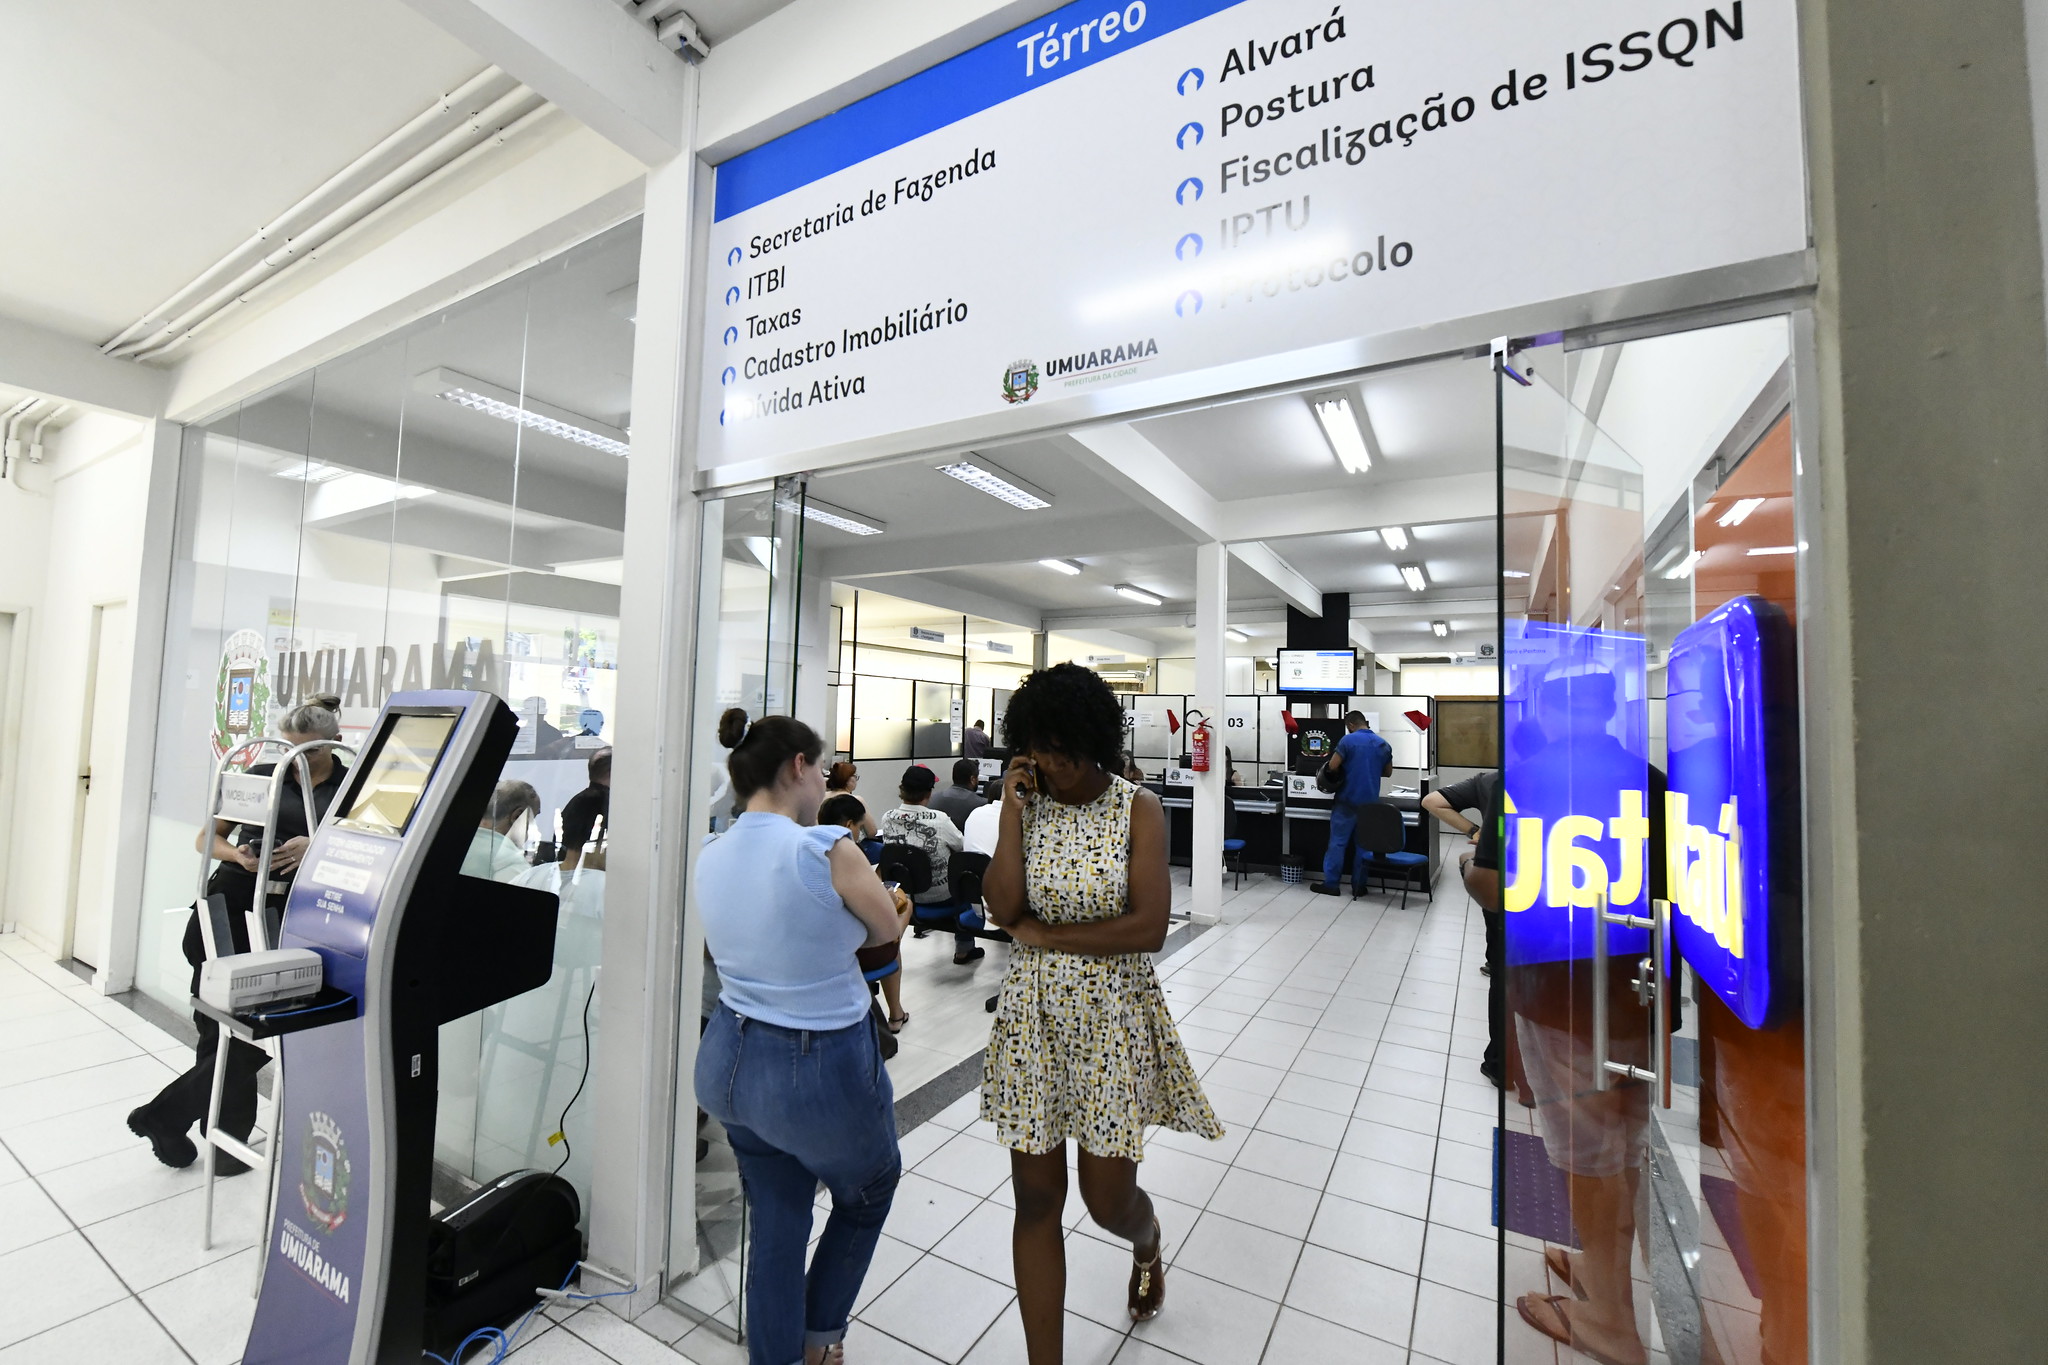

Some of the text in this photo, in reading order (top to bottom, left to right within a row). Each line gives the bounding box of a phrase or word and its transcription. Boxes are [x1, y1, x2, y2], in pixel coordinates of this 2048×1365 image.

[1017, 0, 1147, 77] Térreo
[1220, 5, 1346, 83] Alvará
[1221, 0, 1744, 193] Fiscalização de ISSQN
[1221, 65, 1375, 137] Postura
[750, 148, 997, 259] Secretaria de Fazenda
[1220, 195, 1310, 249] IPTU
[748, 265, 785, 300] ITBI
[744, 298, 968, 380] Cadastro Imobiliário
[745, 308, 801, 339] Taxas
[1046, 338, 1158, 377] UMUARAMA
[1063, 367, 1138, 388] PREFEITURA DA CIDADE
[808, 375, 865, 406] Ativa
[277, 639, 502, 708] UMUARAMA
[1227, 717, 1244, 728] 03
[316, 898, 345, 915] SUA SENHA
[324, 889, 343, 903] RETIRE
[283, 1217, 320, 1254] PREFEITURA DE
[280, 1229, 350, 1305] UMUARAMA
